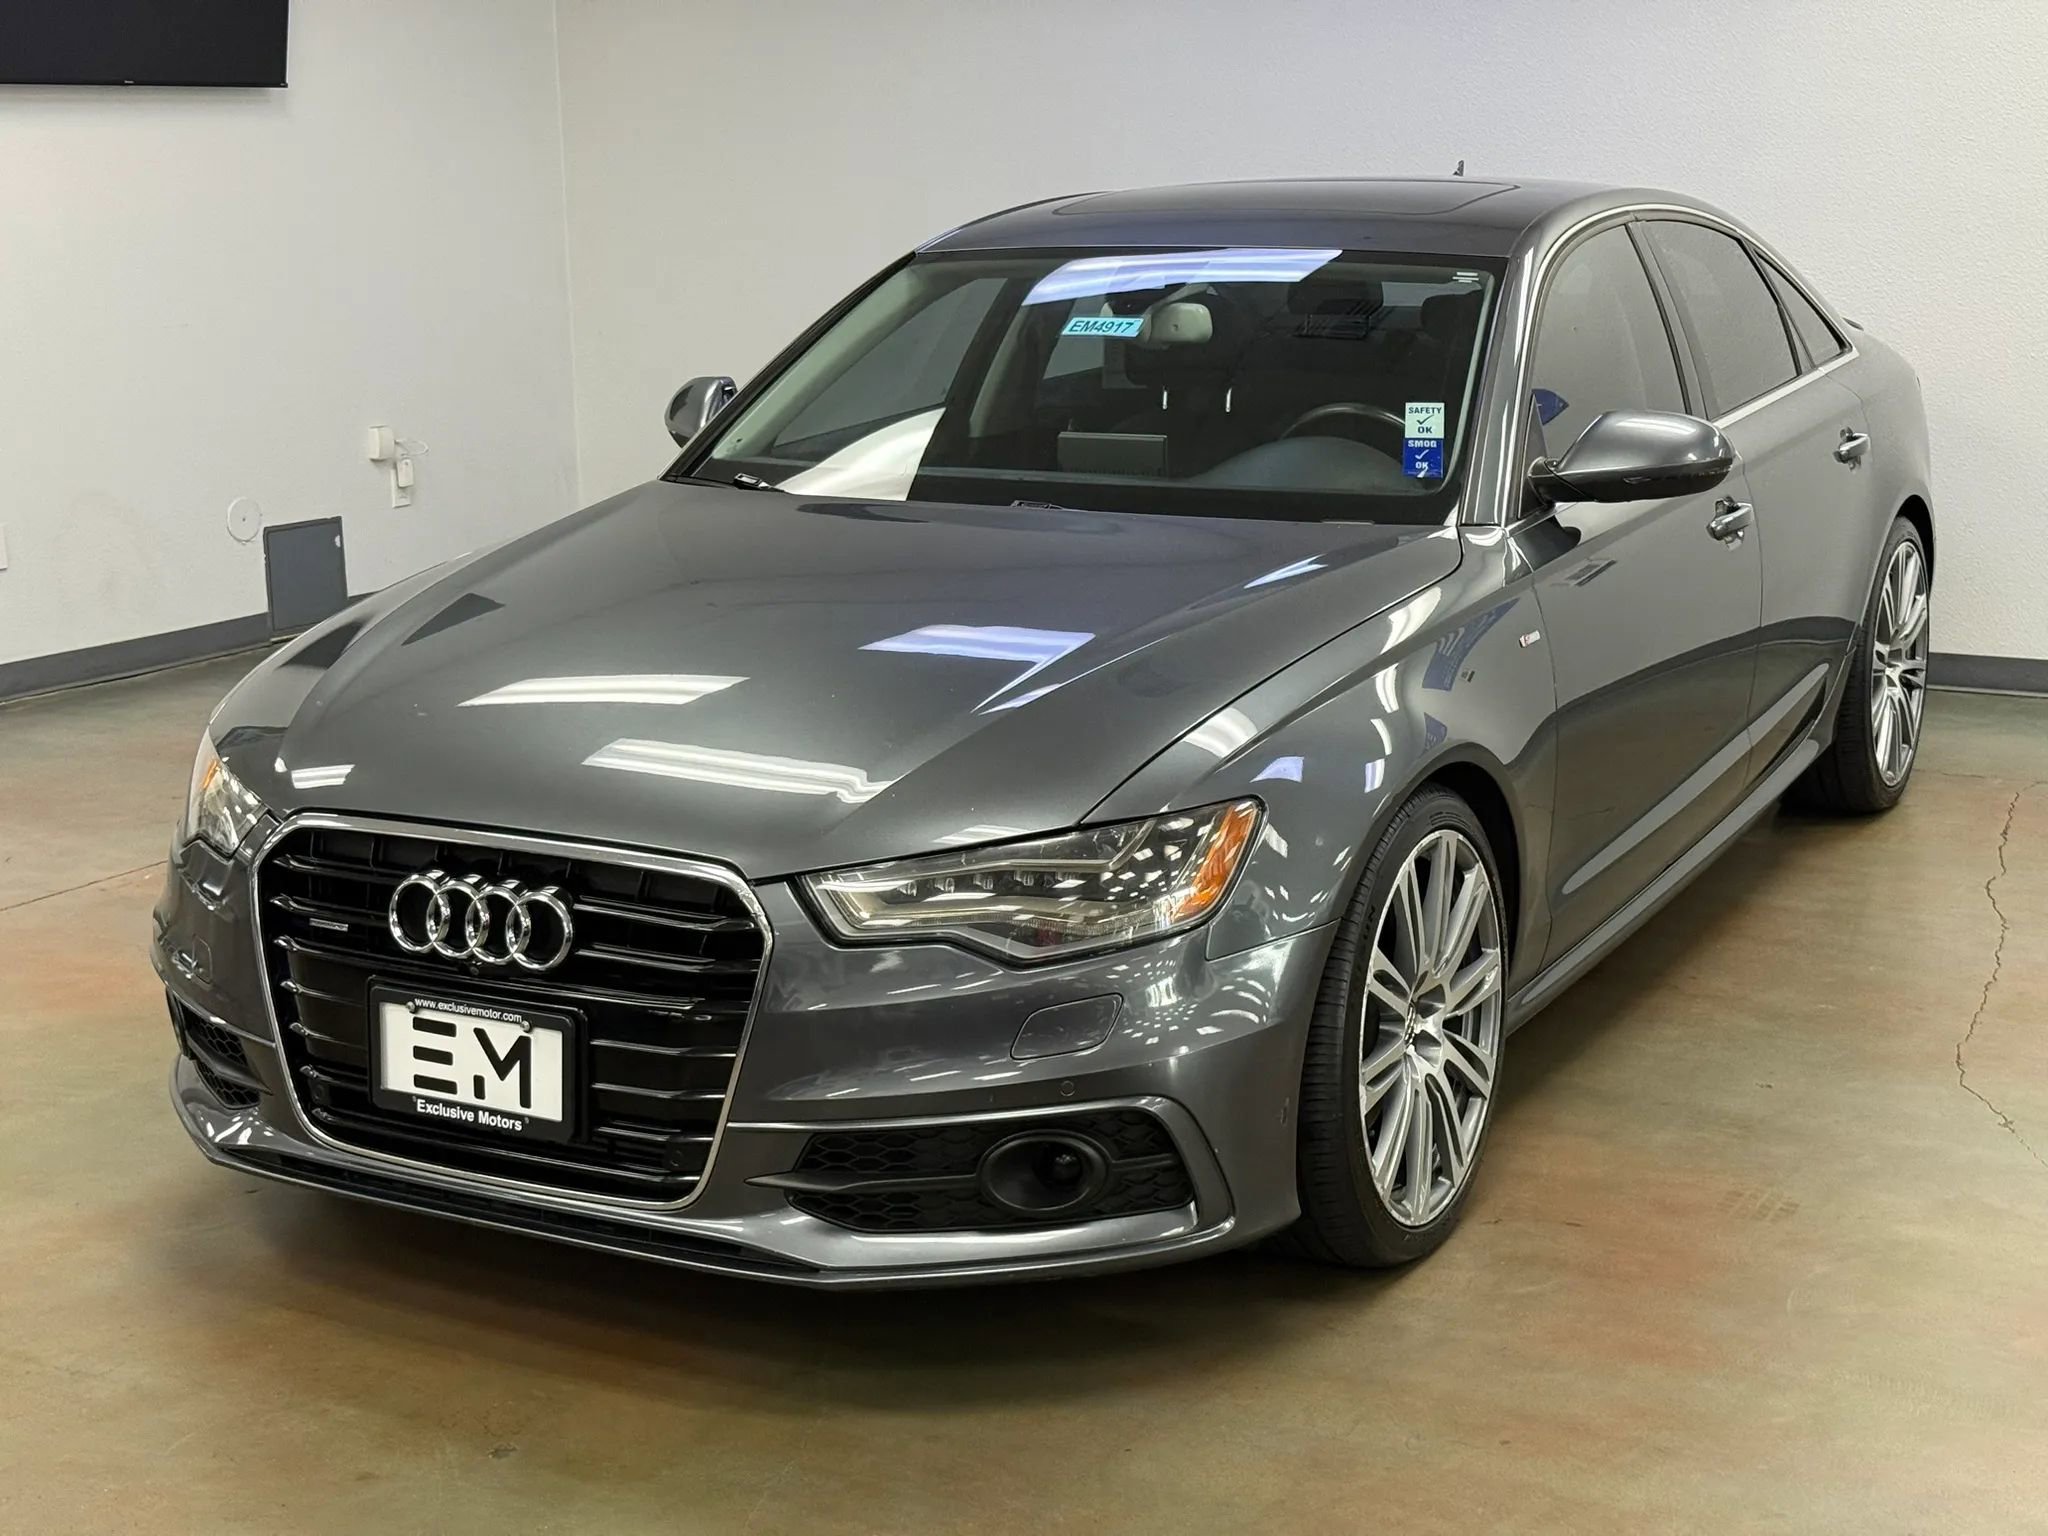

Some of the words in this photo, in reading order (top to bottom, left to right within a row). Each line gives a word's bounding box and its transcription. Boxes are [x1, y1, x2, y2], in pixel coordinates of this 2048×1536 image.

[1069, 320, 1135, 334] EM4917
[1408, 406, 1442, 414] SAFETY
[1417, 426, 1433, 434] OK
[1407, 440, 1437, 448] SMOG
[1415, 461, 1429, 469] OK
[414, 997, 522, 1023] www.exclusivemotor.com
[412, 1016, 532, 1109] EM
[416, 1098, 475, 1122] Exclusive
[478, 1110, 523, 1131] Motors
